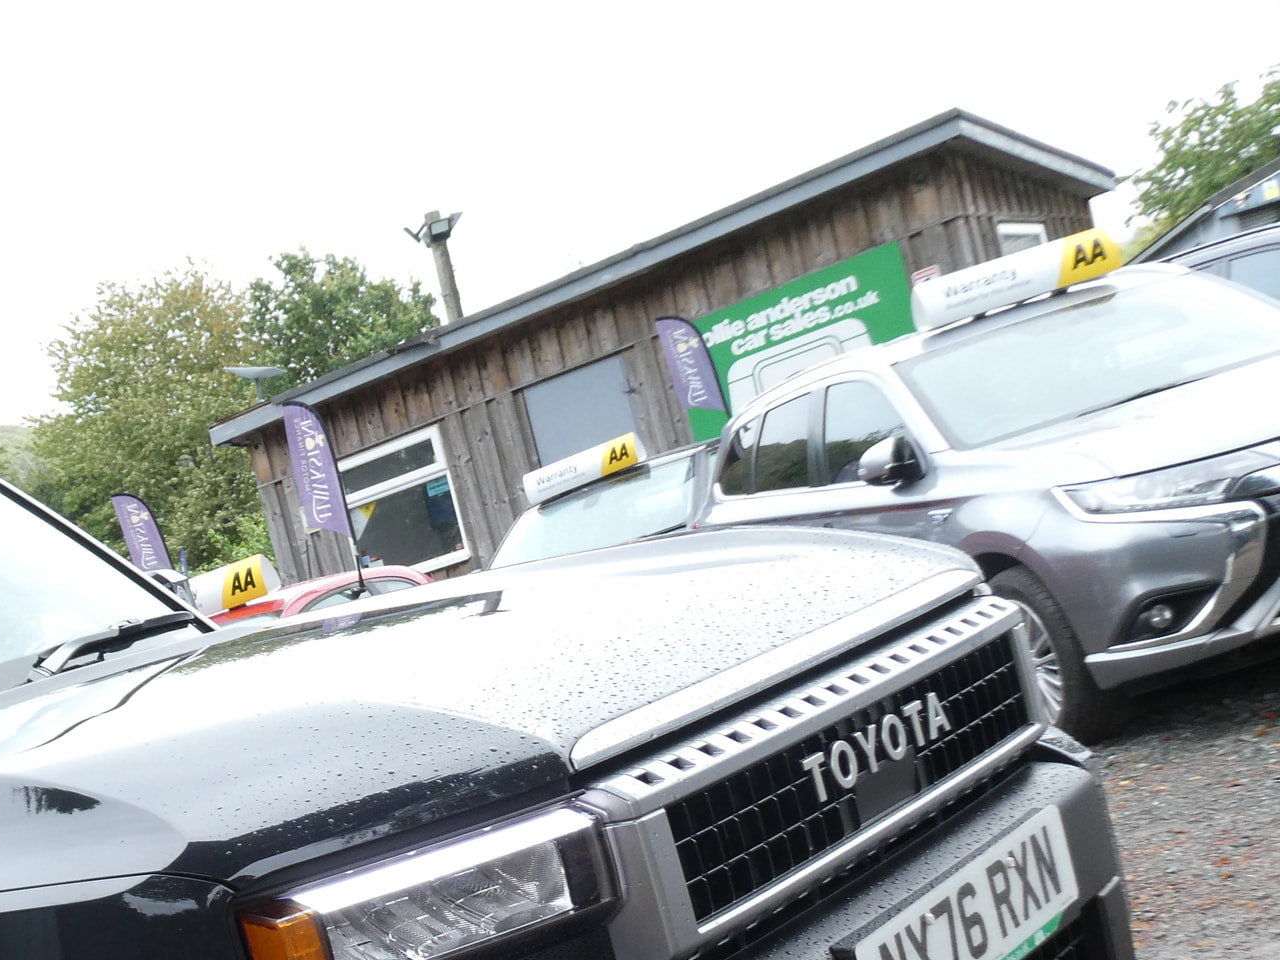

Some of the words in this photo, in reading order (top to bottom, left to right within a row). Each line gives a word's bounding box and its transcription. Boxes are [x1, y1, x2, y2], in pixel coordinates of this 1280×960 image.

[1072, 238, 1108, 270] AA
[731, 328, 769, 356] car
[769, 290, 881, 342] sales.co.uk
[746, 275, 858, 331] anderson
[536, 464, 578, 486] Warranty
[609, 443, 629, 465] AA
[231, 567, 256, 596] AA
[803, 691, 952, 802] TOYOTA
[986, 826, 1062, 938] RXN
